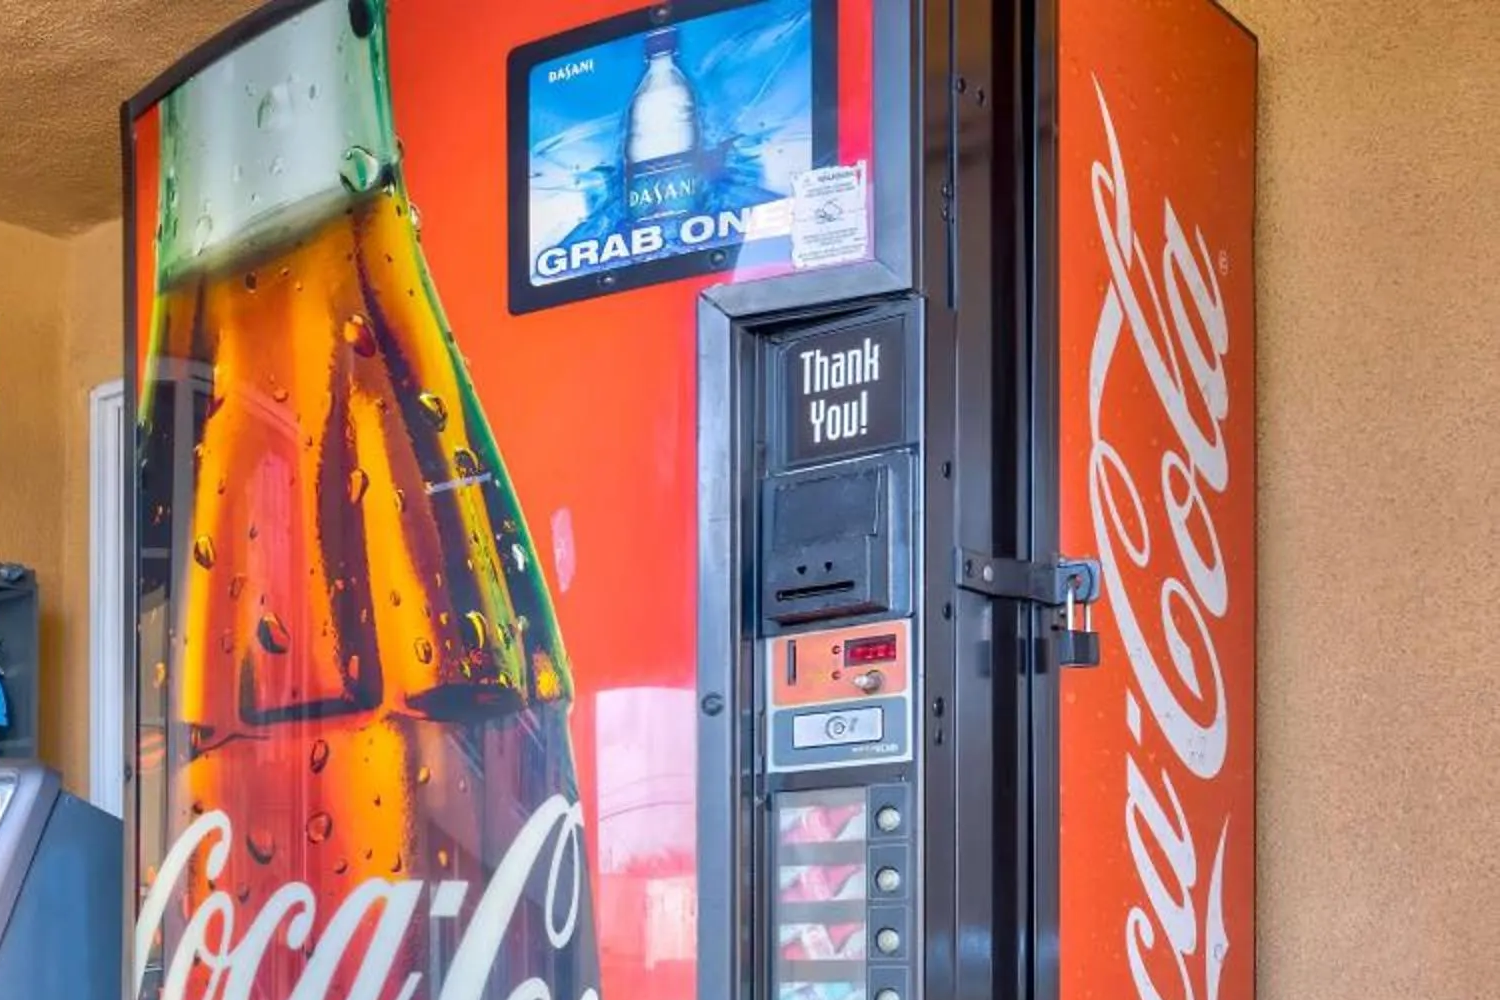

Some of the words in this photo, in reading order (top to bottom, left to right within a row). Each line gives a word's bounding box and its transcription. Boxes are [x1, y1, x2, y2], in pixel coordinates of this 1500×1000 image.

[548, 59, 595, 83] DASANI
[536, 225, 664, 277] GRAB
[799, 338, 880, 395] Thank
[811, 391, 868, 443] You!
